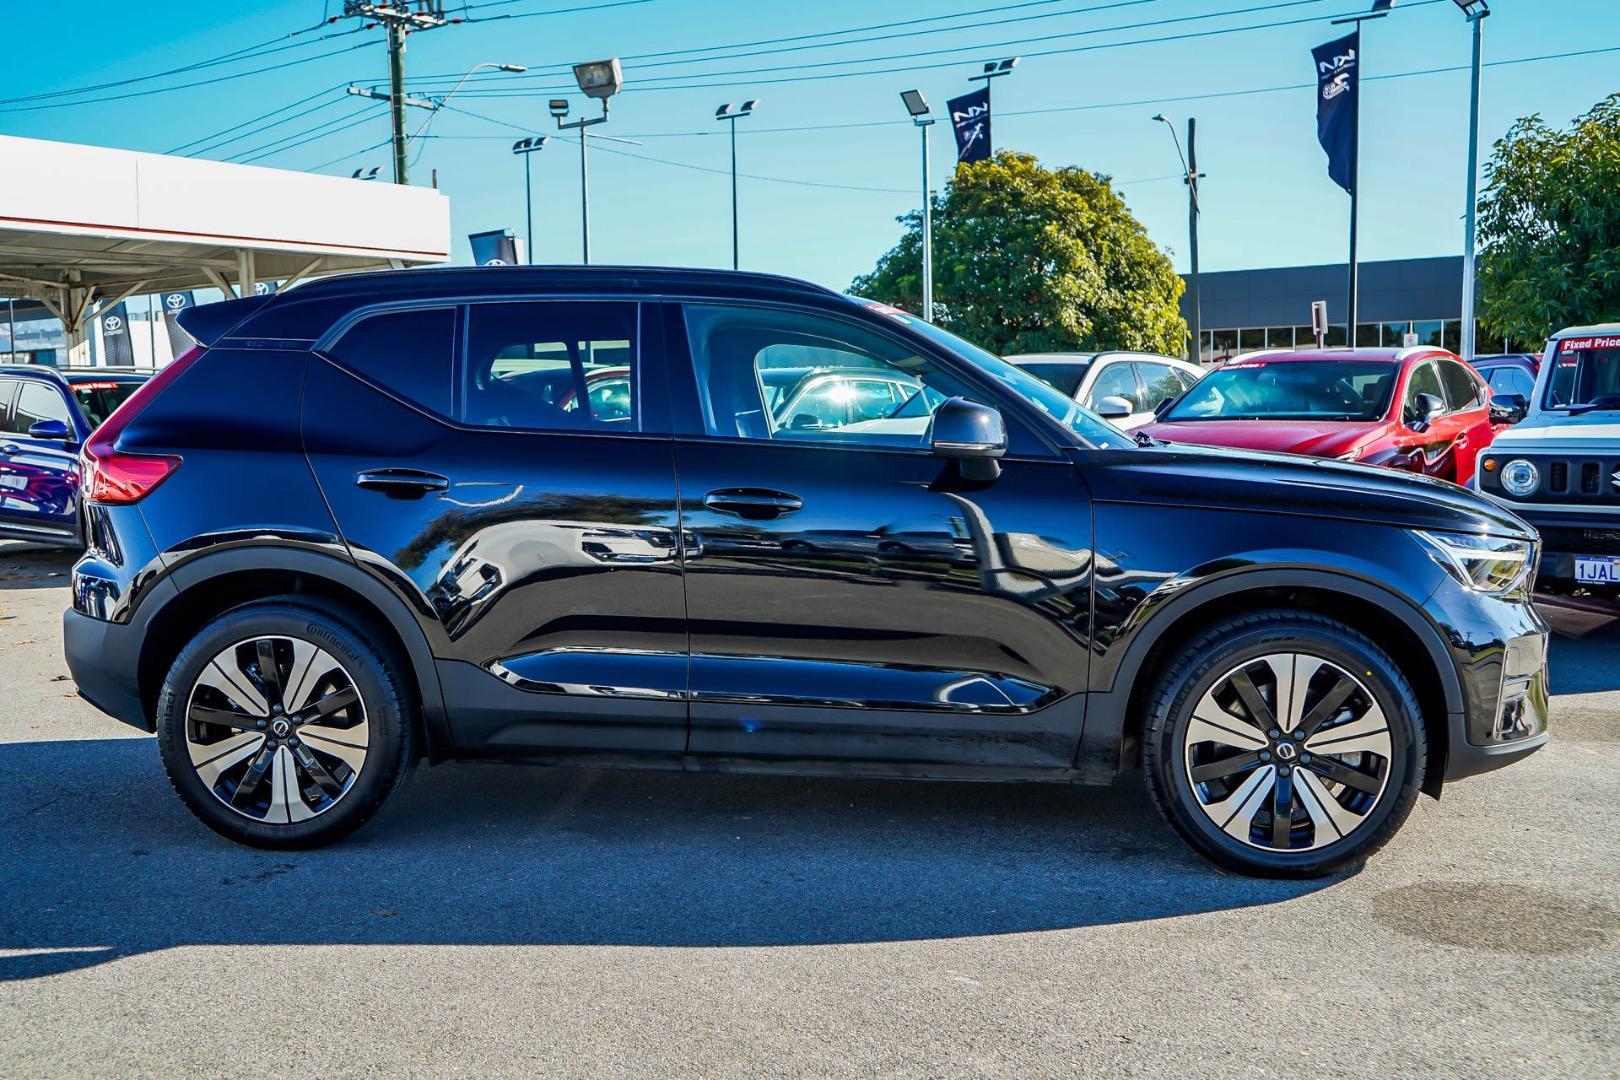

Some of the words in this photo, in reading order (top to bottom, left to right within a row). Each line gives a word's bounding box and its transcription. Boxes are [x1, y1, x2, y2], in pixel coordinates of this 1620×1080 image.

[1563, 339, 1593, 350] Fixed
[1594, 337, 1620, 347] Price
[1579, 562, 1619, 581] 1JAL
